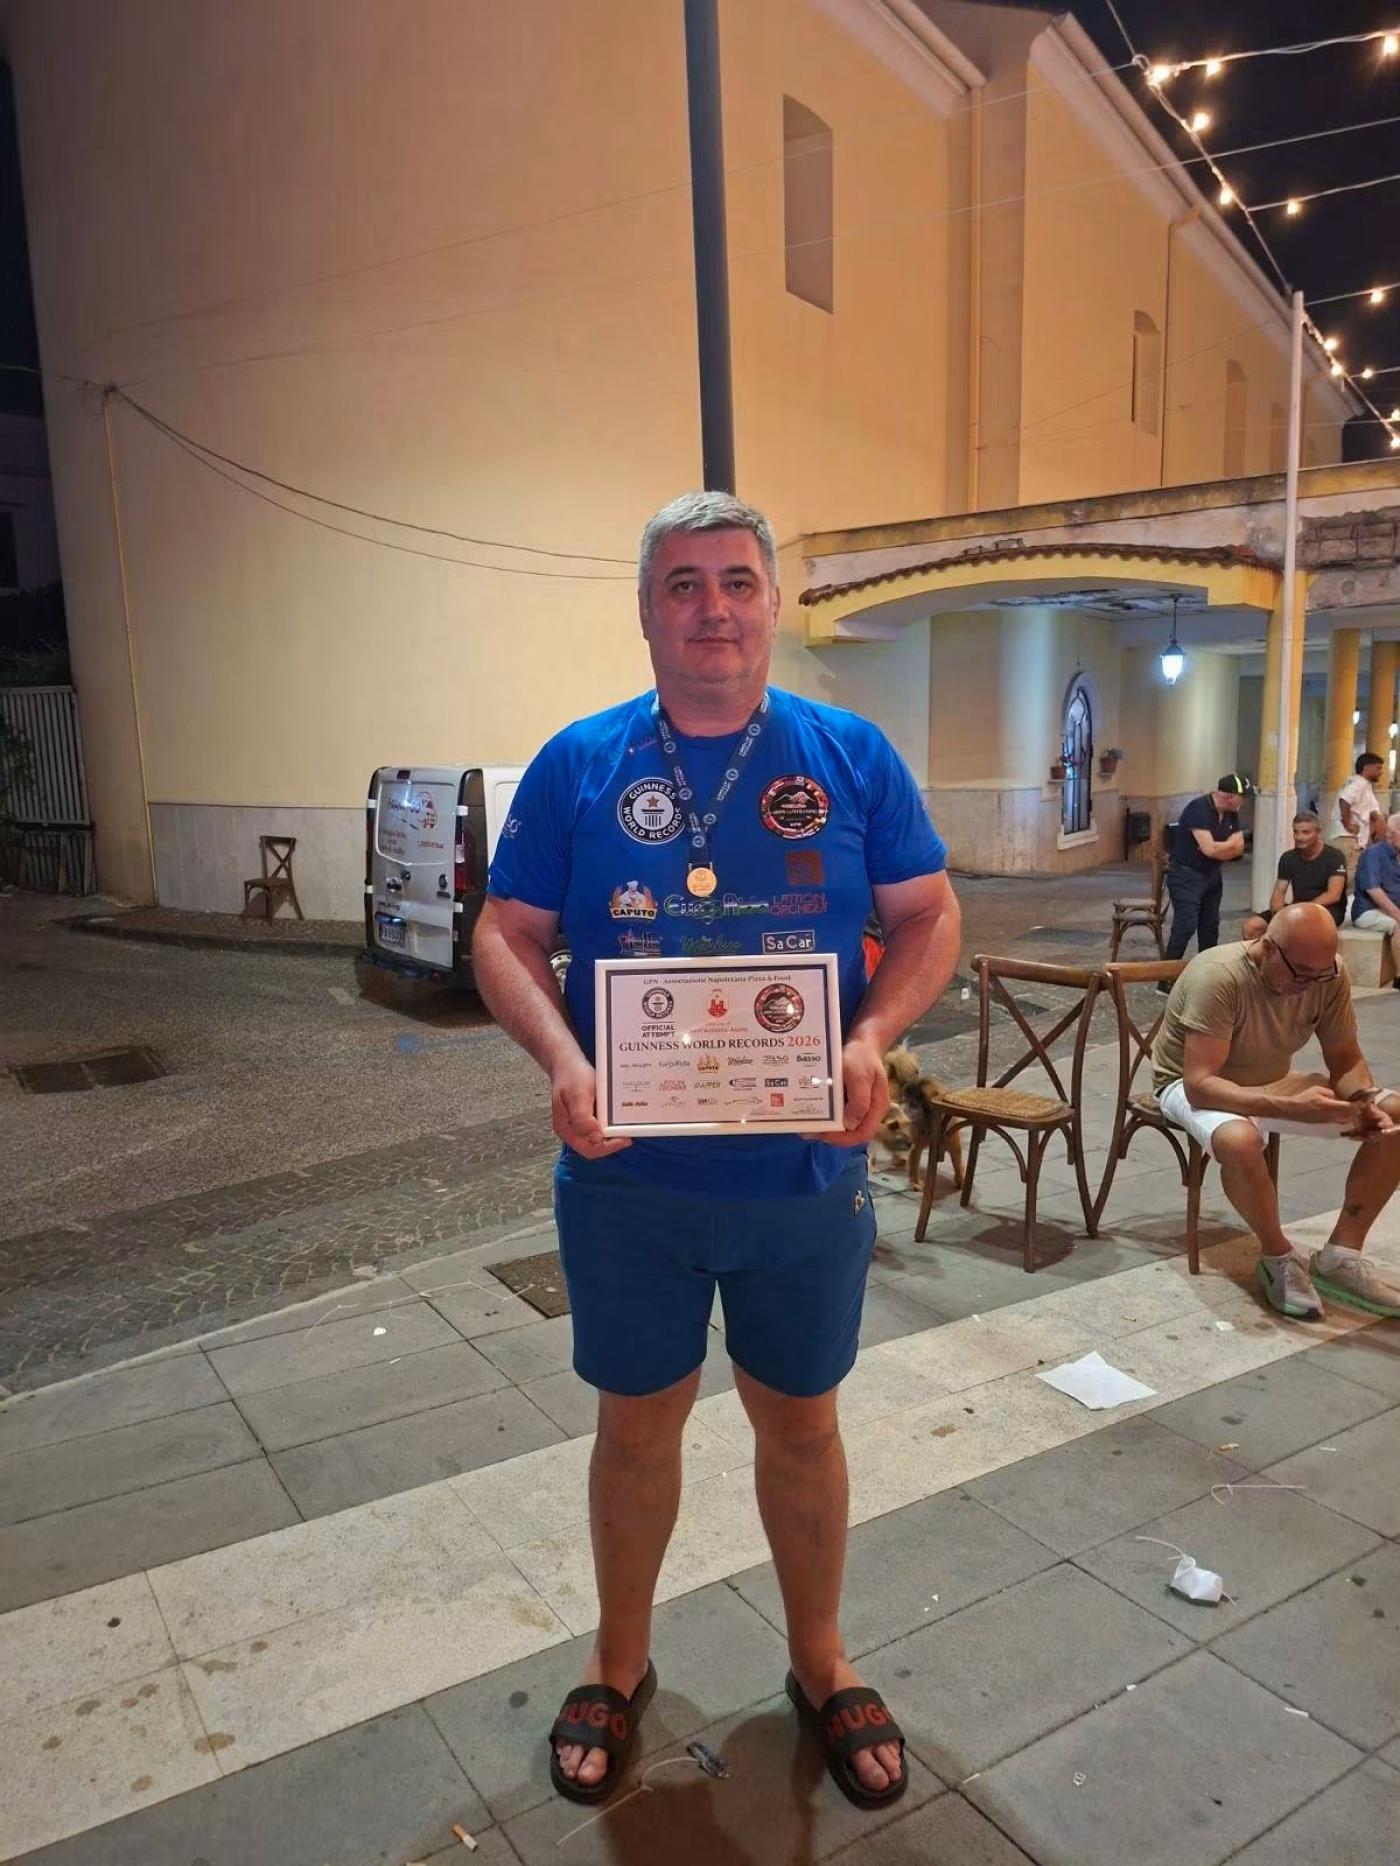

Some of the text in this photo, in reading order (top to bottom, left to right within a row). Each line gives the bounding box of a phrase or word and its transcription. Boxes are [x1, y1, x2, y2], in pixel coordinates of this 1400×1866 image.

[629, 783, 677, 800] GUINNESS
[623, 807, 645, 836] WORLD
[613, 908, 655, 918] CAPUTO
[641, 1024, 675, 1032] OFFICIAL
[619, 1035, 820, 1052] GUINNESS WORLD RECORDS 2026
